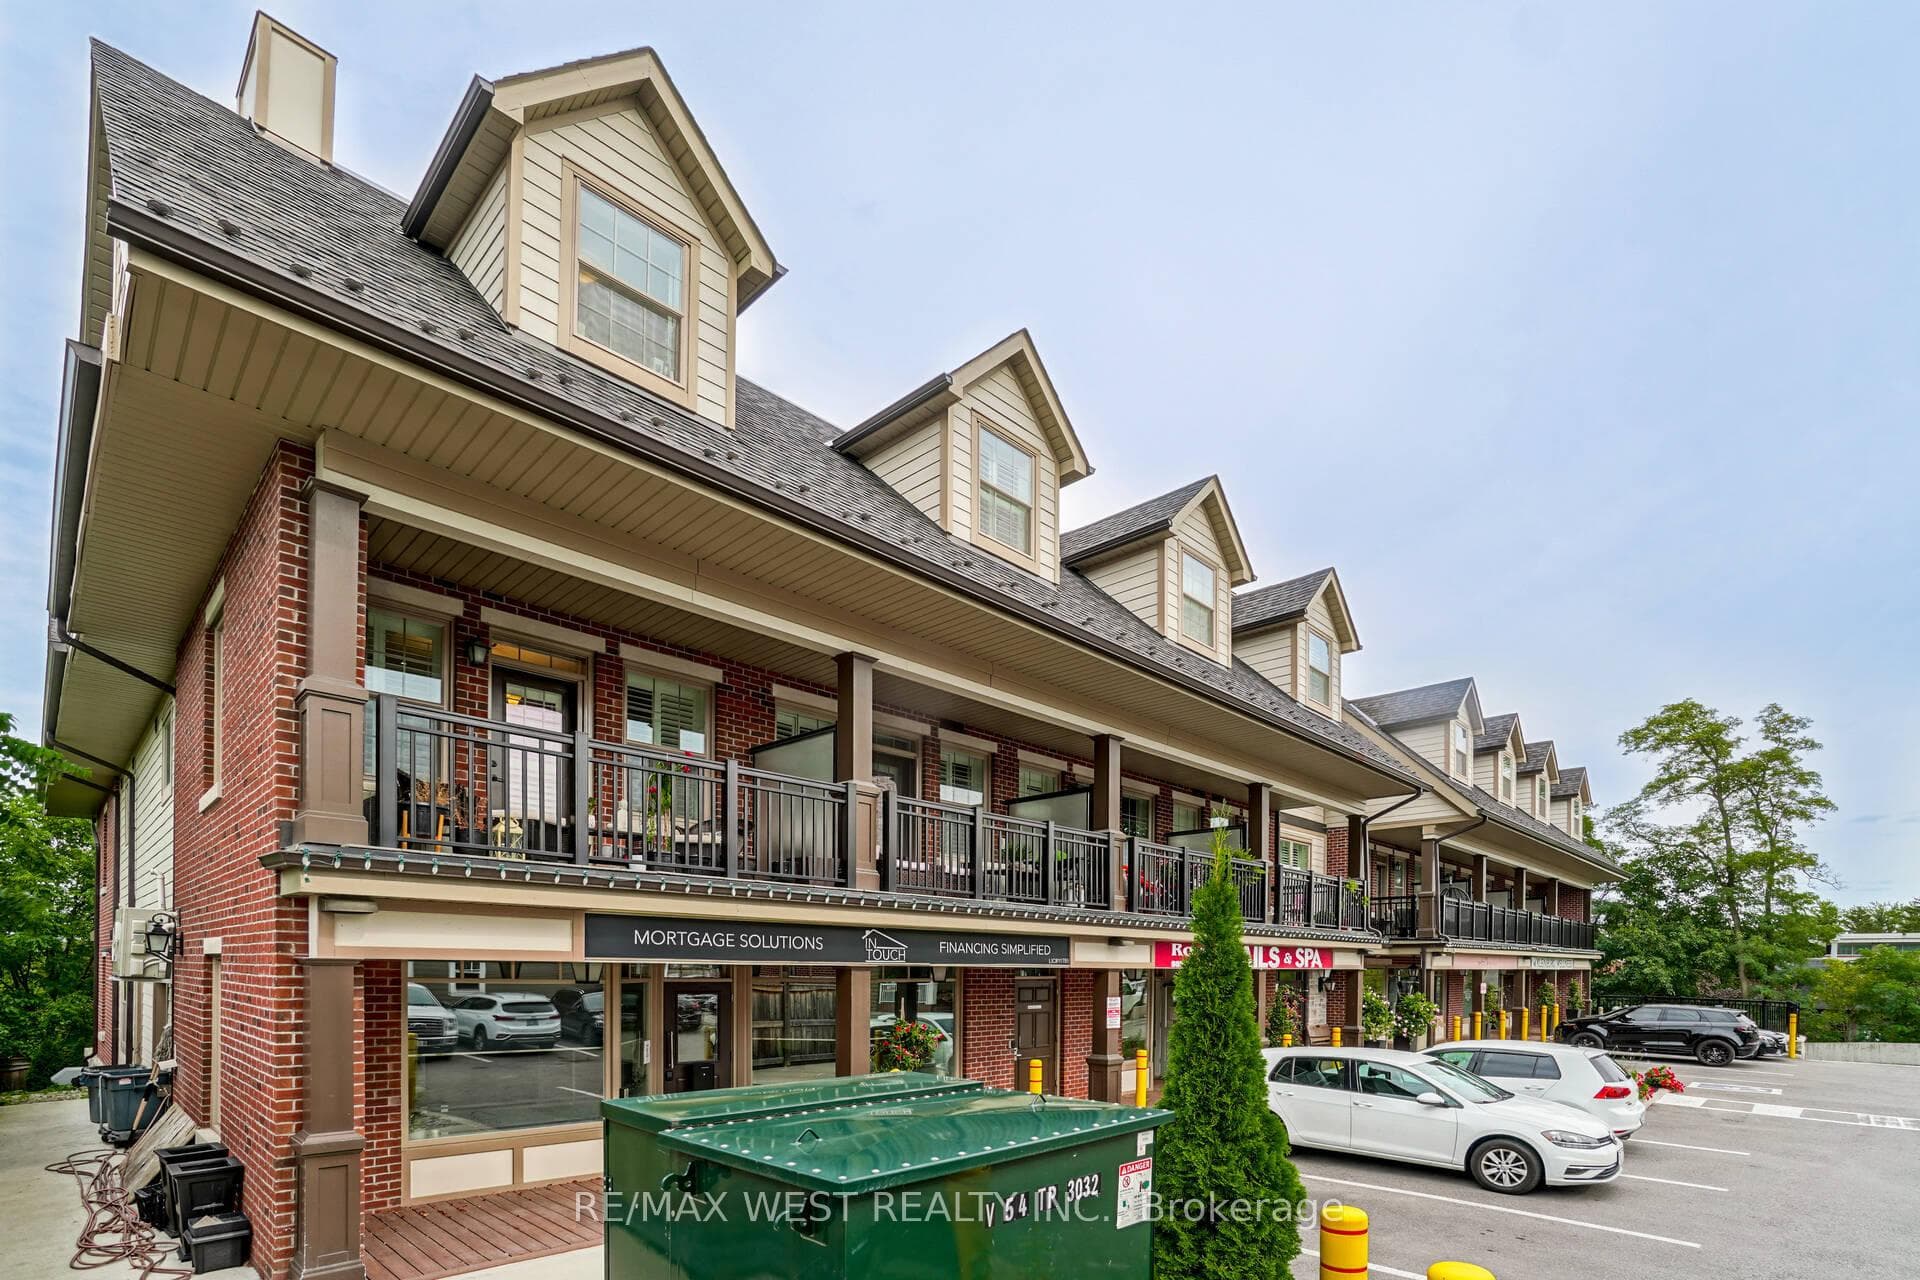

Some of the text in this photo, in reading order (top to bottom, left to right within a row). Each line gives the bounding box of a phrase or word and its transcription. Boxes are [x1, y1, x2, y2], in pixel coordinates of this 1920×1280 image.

[634, 929, 824, 950] MORTGAGE SOLUTIONS
[865, 937, 877, 949] IN
[865, 949, 906, 961] TOUCH
[939, 941, 1051, 956] FINANCING SIMPLIFIED
[1170, 942, 1194, 957] Ro
[1283, 952, 1293, 965] &
[1295, 947, 1323, 968] SPA
[1127, 1159, 1150, 1173] DANGER
[1038, 1185, 1058, 1212] TR
[1067, 1173, 1100, 1203] 3032
